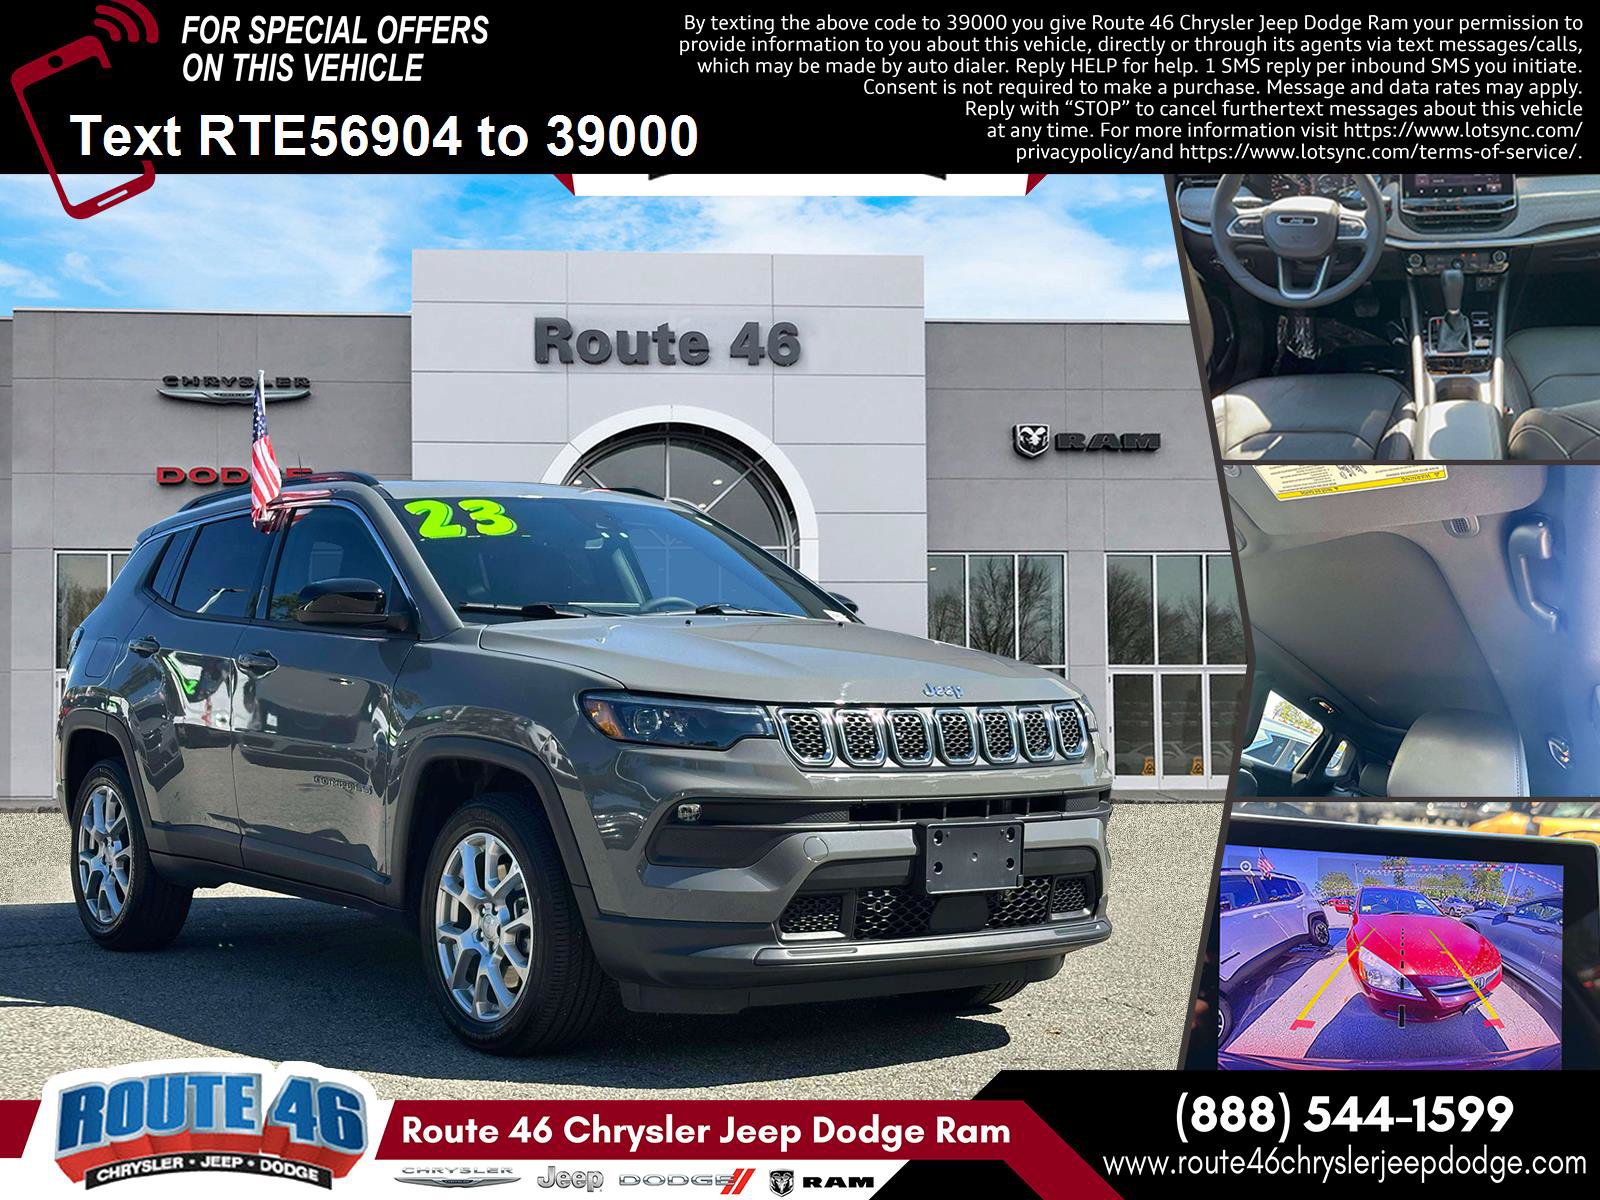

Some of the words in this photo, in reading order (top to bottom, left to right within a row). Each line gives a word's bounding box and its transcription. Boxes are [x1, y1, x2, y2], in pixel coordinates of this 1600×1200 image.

[534, 317, 710, 365] Route
[730, 321, 802, 367] 46
[1055, 433, 1161, 451] RAM
[156, 467, 313, 485] DODE
[403, 499, 518, 539] 23
[922, 682, 964, 700] Jeep
